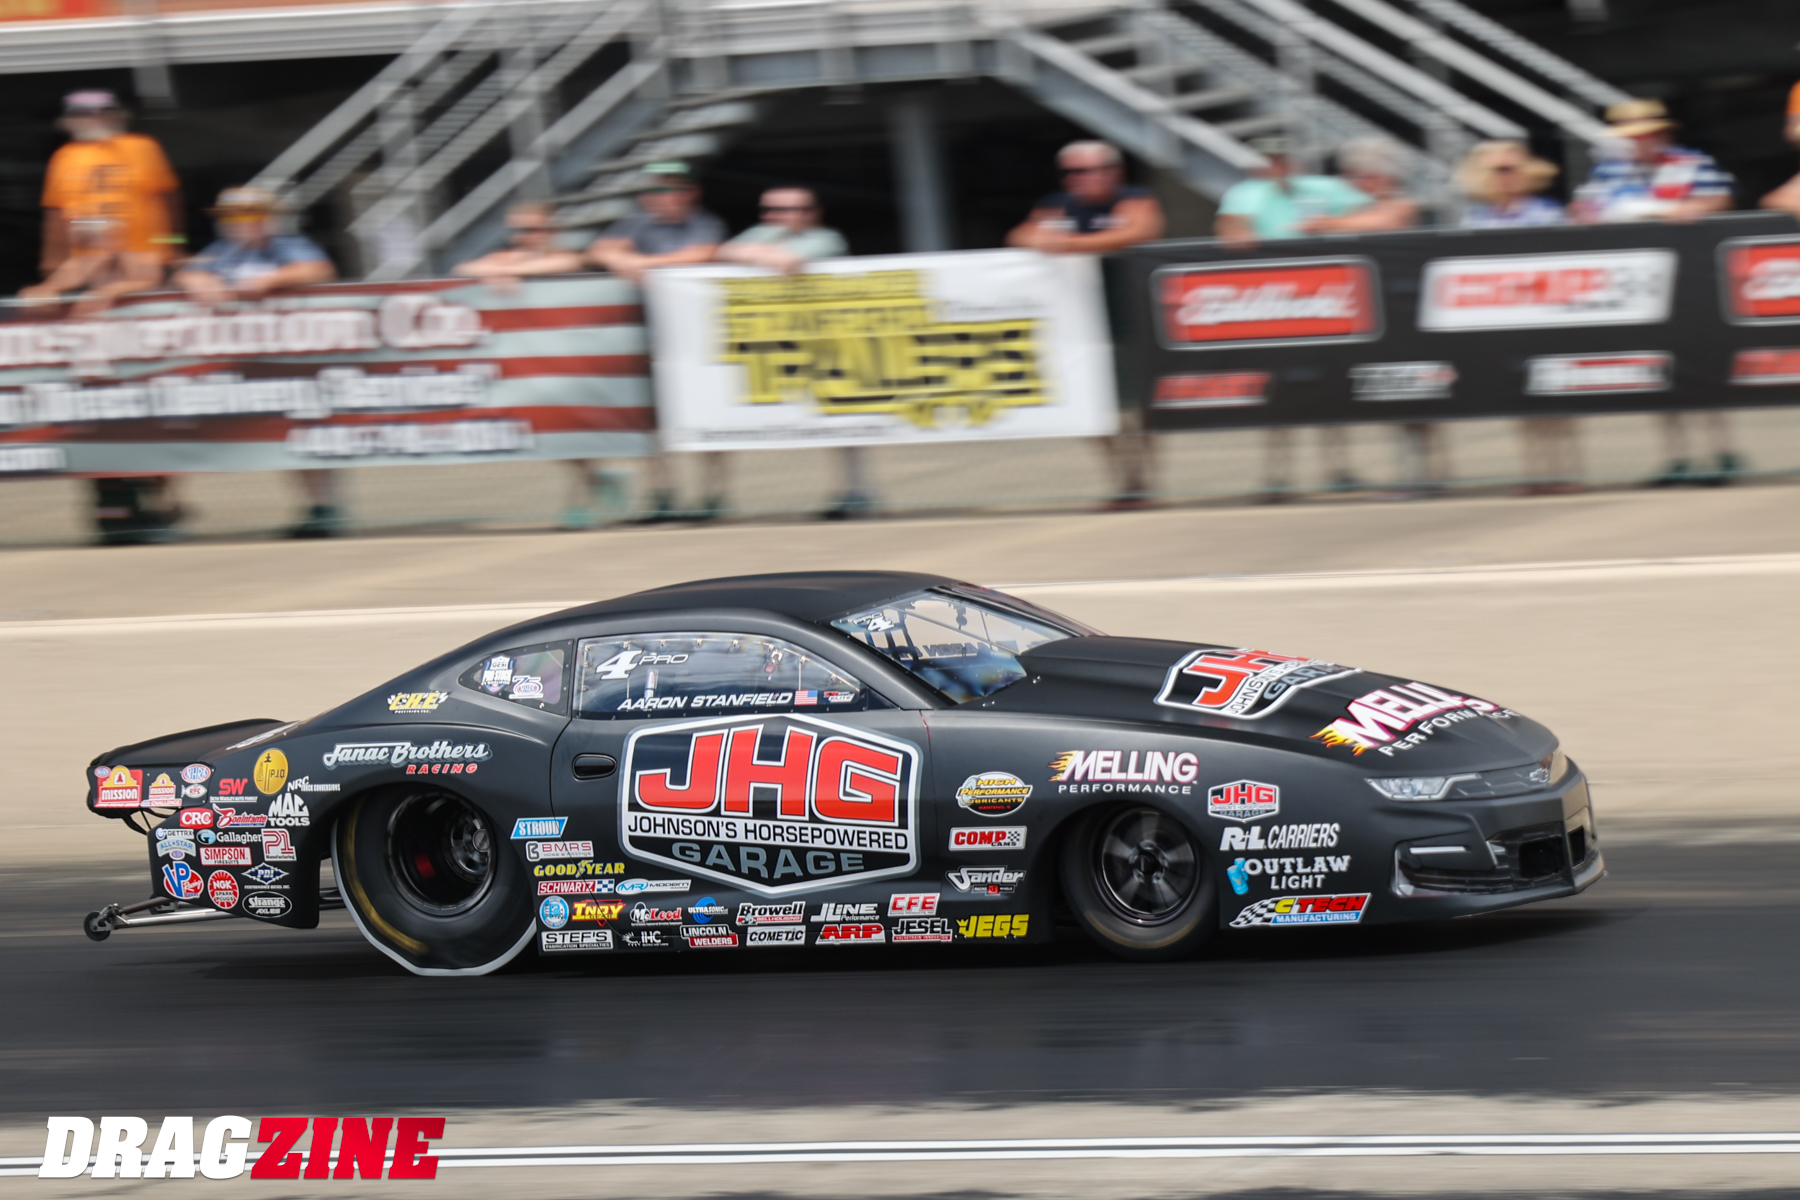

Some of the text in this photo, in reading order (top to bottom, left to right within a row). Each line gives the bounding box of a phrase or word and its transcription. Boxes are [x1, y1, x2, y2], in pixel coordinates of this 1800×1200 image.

[596, 649, 689, 680] 4 PRO
[616, 693, 793, 711] AARON STANFIELD
[325, 741, 494, 769] Janac Brothers
[185, 767, 208, 780] NHRA
[406, 764, 479, 775] RACING
[1058, 750, 1199, 783] MELLING
[635, 722, 904, 827] JHG
[219, 779, 248, 795] SW
[288, 776, 309, 792] NRC
[1058, 783, 1191, 794] PERFORMANCE
[101, 788, 138, 802] MISSION
[960, 788, 1030, 796] PERFORMANCE
[1212, 784, 1275, 805] JHG
[268, 793, 309, 817] MAC
[181, 811, 212, 825] CRC
[1219, 808, 1267, 818] GARAGE
[269, 818, 310, 826] TOOLS
[518, 820, 561, 837] STROUD
[216, 831, 262, 845] Gallagher
[628, 814, 909, 851] JOHNSON'S HORSEPOWERED
[954, 831, 1007, 845] COMP
[1267, 822, 1341, 849] CARRIERS
[204, 848, 248, 860] SIMPSON
[541, 842, 592, 852] BMRS
[671, 841, 864, 879] GARAGE
[1244, 855, 1351, 876] OUTLAW
[257, 869, 275, 878] PDI
[534, 860, 625, 878] GOODYEAR
[163, 863, 191, 898] VP
[213, 880, 233, 890] NGK
[539, 881, 596, 894] SCHWARTZ
[1270, 875, 1326, 890] LIGHT
[248, 896, 287, 908] Strange
[738, 902, 804, 916] Browell
[891, 896, 937, 911] CFE
[633, 907, 682, 922] McLeod
[1275, 912, 1357, 923] MANUFACTURING
[683, 926, 728, 938] LINCOLN
[820, 924, 883, 940] ARP
[892, 919, 952, 935] JESEL
[958, 914, 1029, 939] JEGS
[545, 931, 608, 944] STEF'S
[641, 930, 662, 943] IHC
[693, 937, 733, 946] WELDERS
[749, 929, 804, 942] COMETIC
